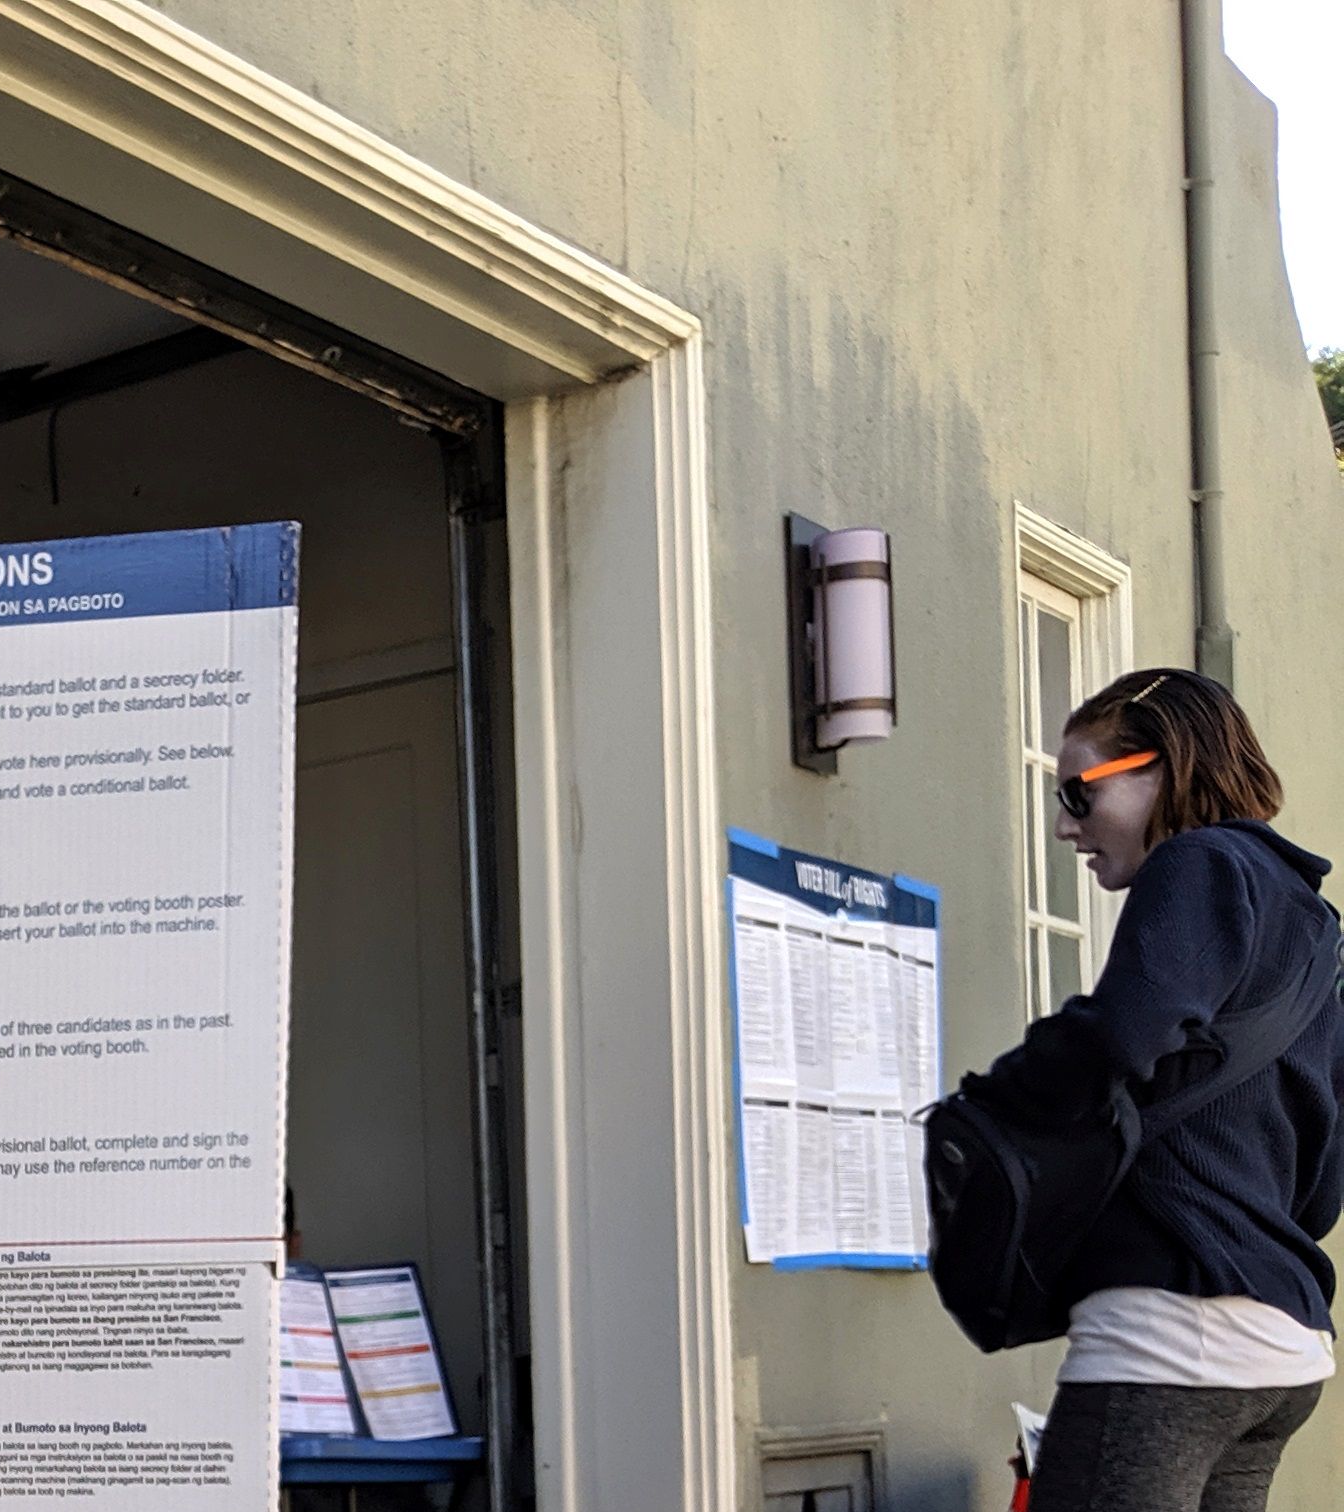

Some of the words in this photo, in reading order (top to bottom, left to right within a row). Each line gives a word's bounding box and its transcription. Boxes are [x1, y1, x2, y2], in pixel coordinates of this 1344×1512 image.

[24, 598, 45, 615] SA
[48, 592, 124, 613] PAGBOTO
[1, 1254, 15, 1265] ng
[17, 1250, 51, 1263] Balota
[2, 1423, 12, 1433] at
[15, 1422, 56, 1433] Bumoto
[59, 1424, 71, 1433] sa
[74, 1422, 110, 1435] Inyong
[113, 1421, 147, 1433] Balota
